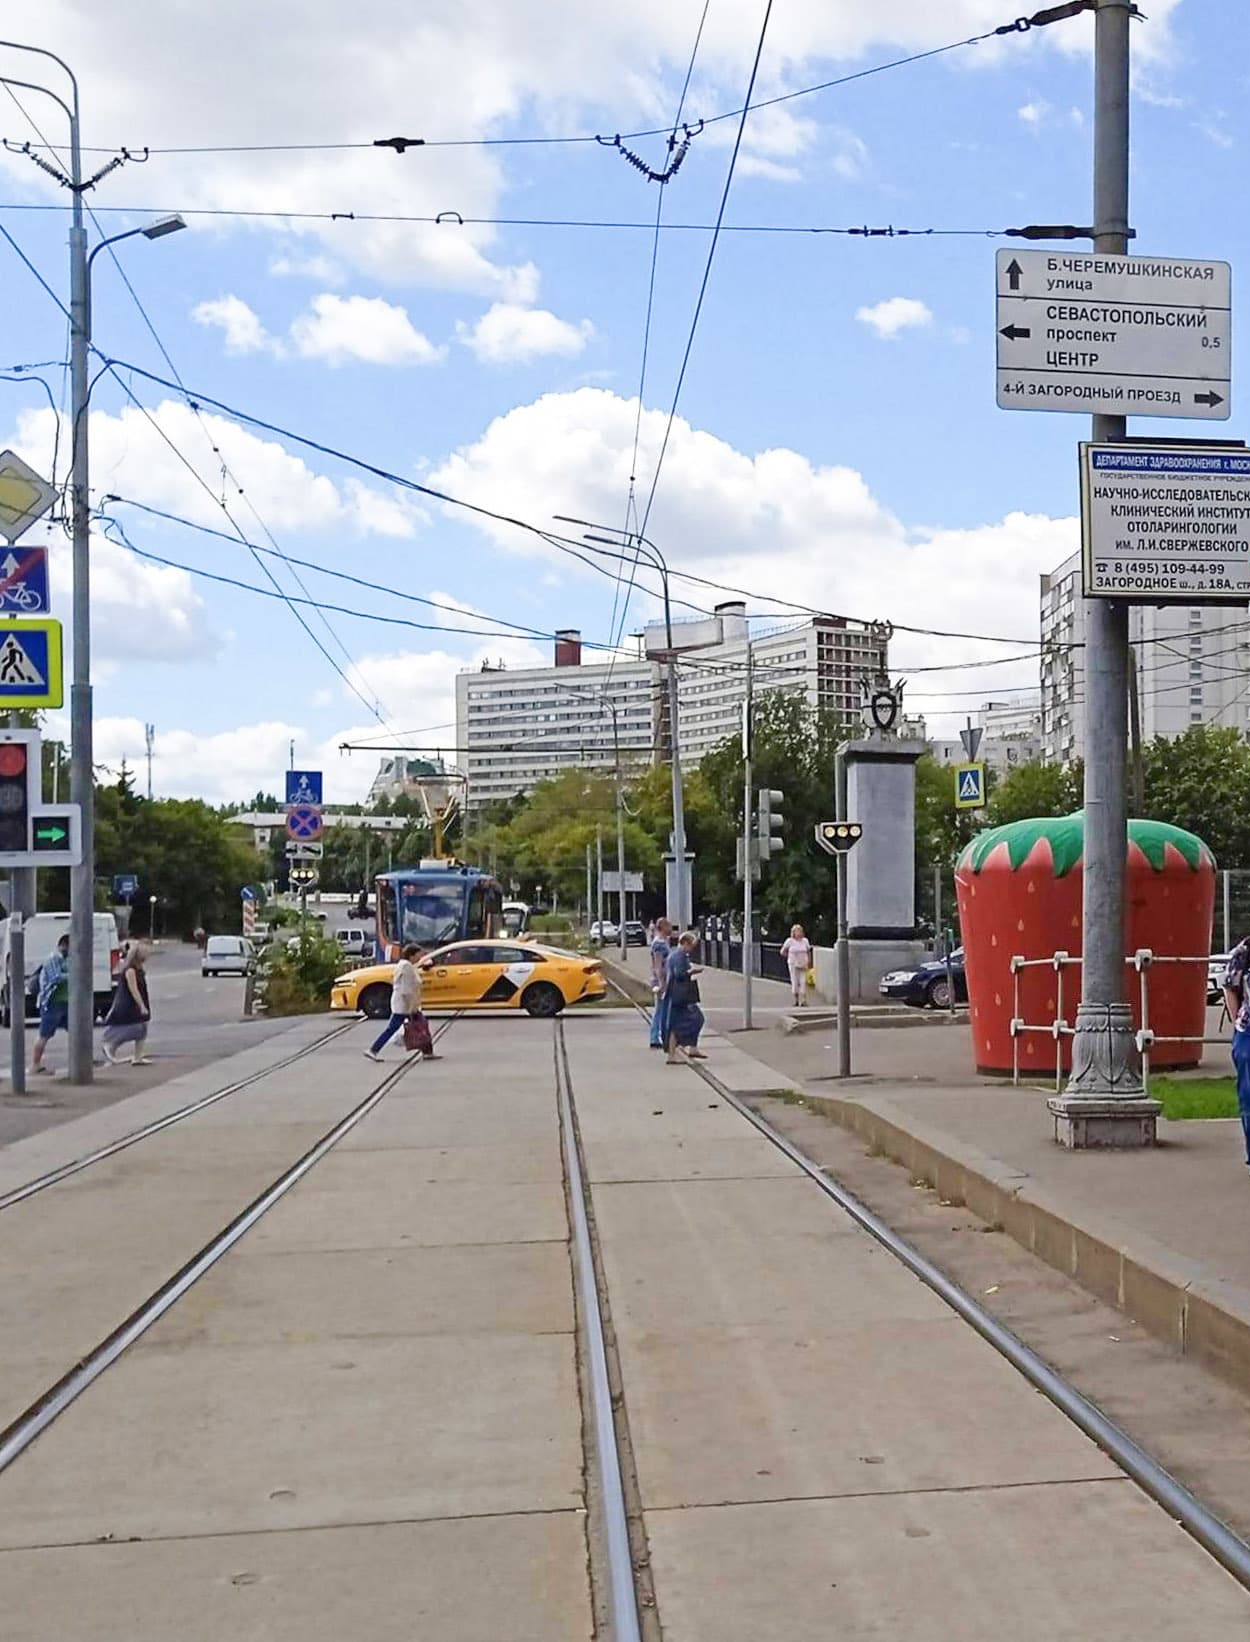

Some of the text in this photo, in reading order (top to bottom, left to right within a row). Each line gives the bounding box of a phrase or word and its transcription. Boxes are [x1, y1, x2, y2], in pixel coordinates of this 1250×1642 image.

[1047, 258, 1214, 280] Б.ЧЕРЕМУШКИНСКАЯ
[1047, 278, 1093, 291] улица
[1047, 306, 1207, 328] СЕВАСТОПОЛЬСКИЙ
[1047, 328, 1117, 343] проспект
[1201, 336, 1221, 350] 0,5
[1046, 351, 1099, 367] ЦЕНТР
[1003, 381, 1181, 404] 4-Й ЗАГОРОДНЫЙ ПРОЕЗД
[1096, 455, 1148, 467] ДЕПАРТАМЕНТ
[1150, 456, 1222, 469] ЗДРАВООХРАНЕНИЯ
[1111, 504, 1250, 519] КЛИНИЧЕСКИЙ ИНСТИТУТ
[1127, 521, 1237, 534] ОТОЛАРИНГОЛОГИИ
[1137, 538, 1249, 552] Л.И.СВЕРЖЕВСКОГО
[1114, 563, 1225, 575] 8 (495) 109-44-99
[1096, 577, 1177, 589] ЗАГОРОДНОЕ
